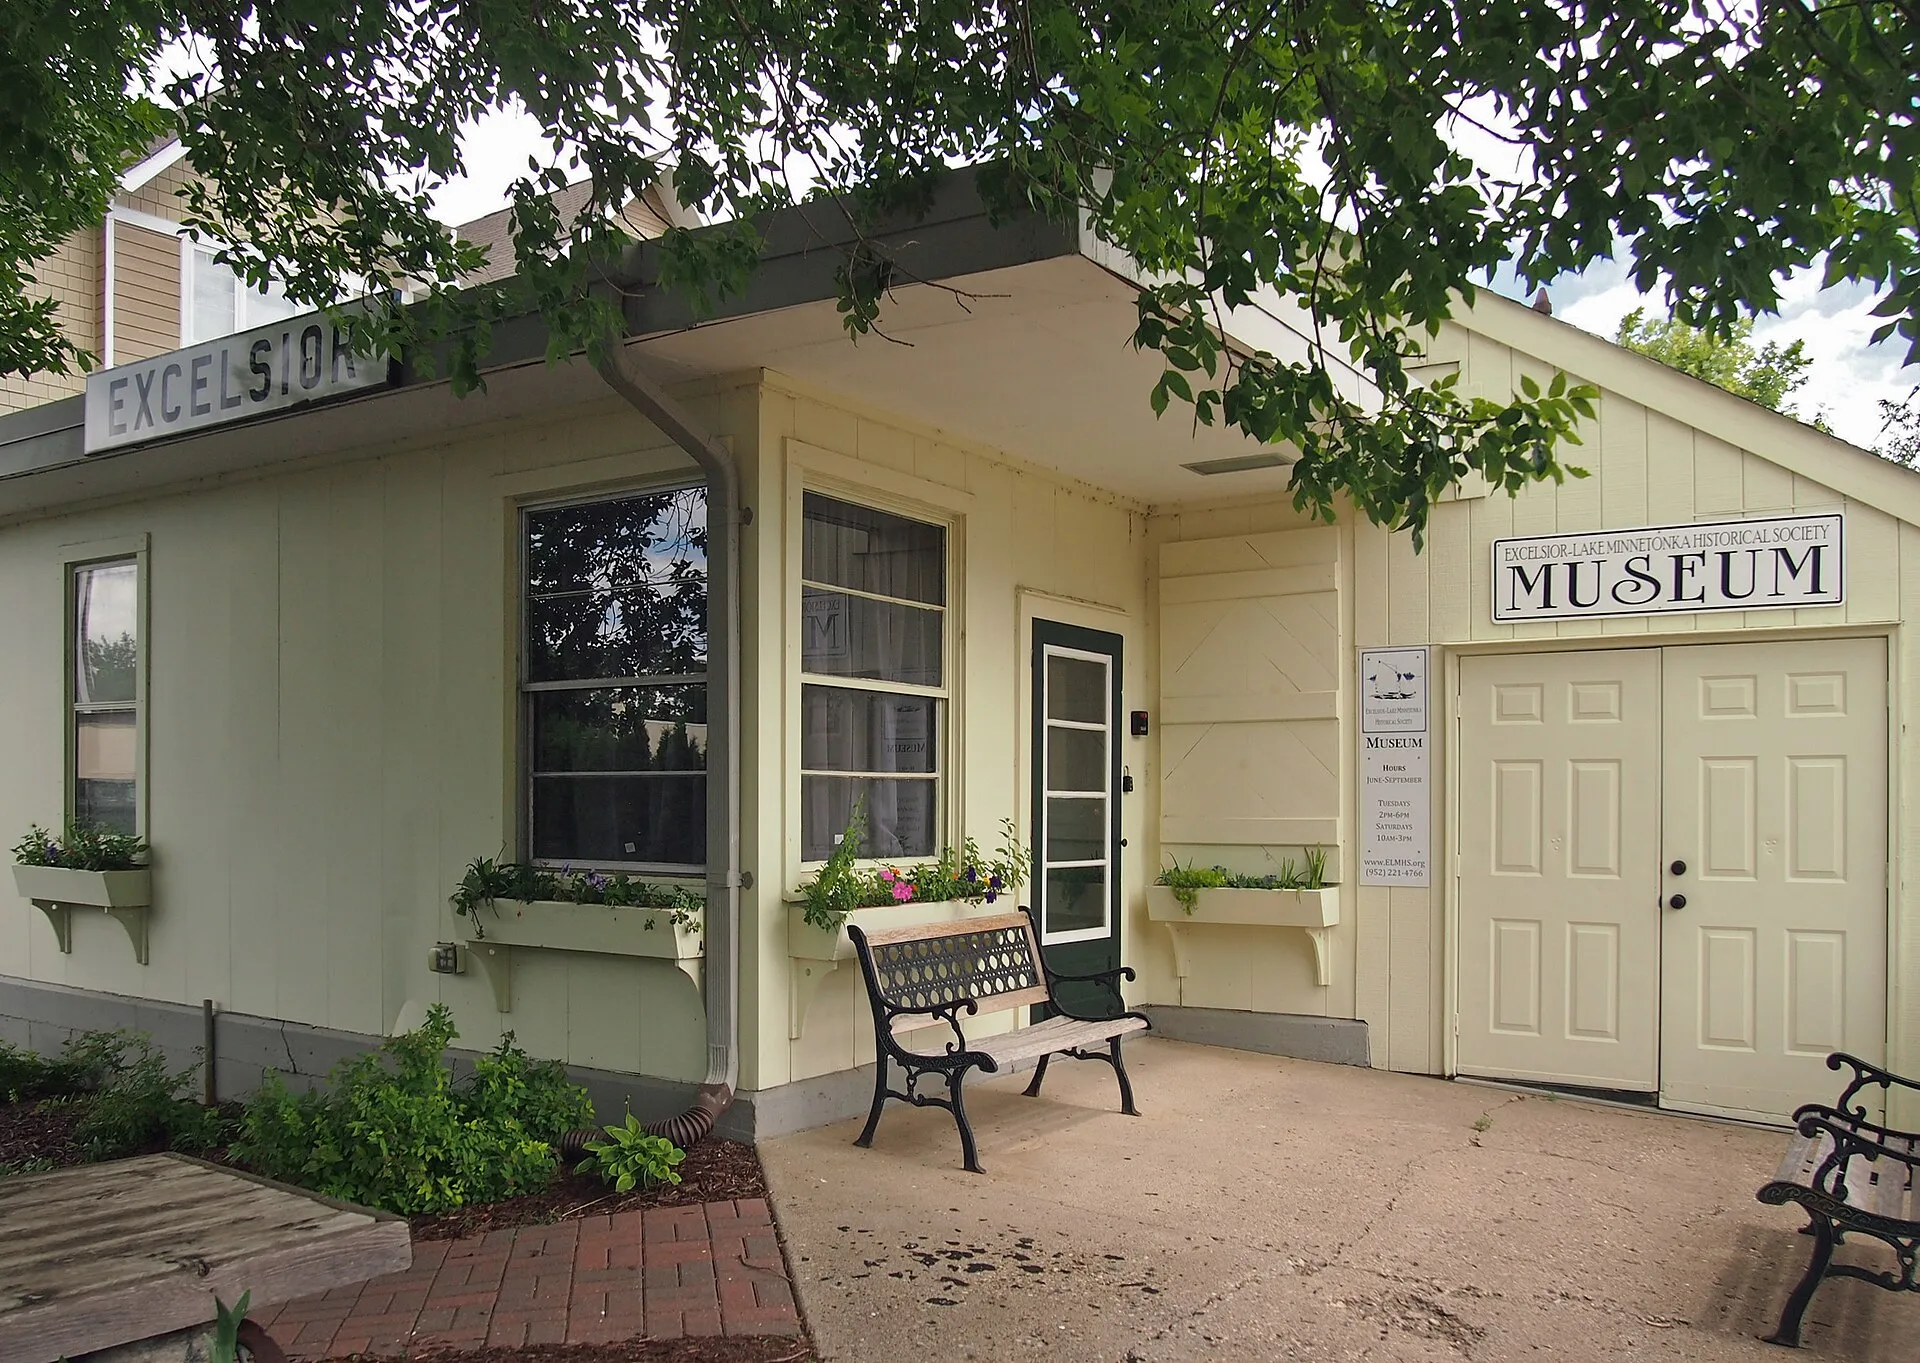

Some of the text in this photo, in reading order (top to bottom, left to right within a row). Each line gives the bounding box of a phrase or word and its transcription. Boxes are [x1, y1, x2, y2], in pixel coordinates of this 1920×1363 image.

[109, 315, 356, 437] EXCELSIOR
[1505, 524, 1830, 562] EXCELSIOR-LAKE MINNETONKA HISTORICAL SOCIETY
[1505, 544, 1829, 611] MUSEUM
[1366, 736, 1423, 749] MUSEUM
[1382, 764, 1406, 772] HOURS
[1366, 776, 1422, 785] JUNE-SEPTEMBER
[1377, 799, 1411, 807] TUESDAYS
[1375, 822, 1413, 830] SATURDAYS
[1363, 858, 1426, 869] www.ELMHS.org
[1365, 868, 1424, 878] (952) 221-4766
